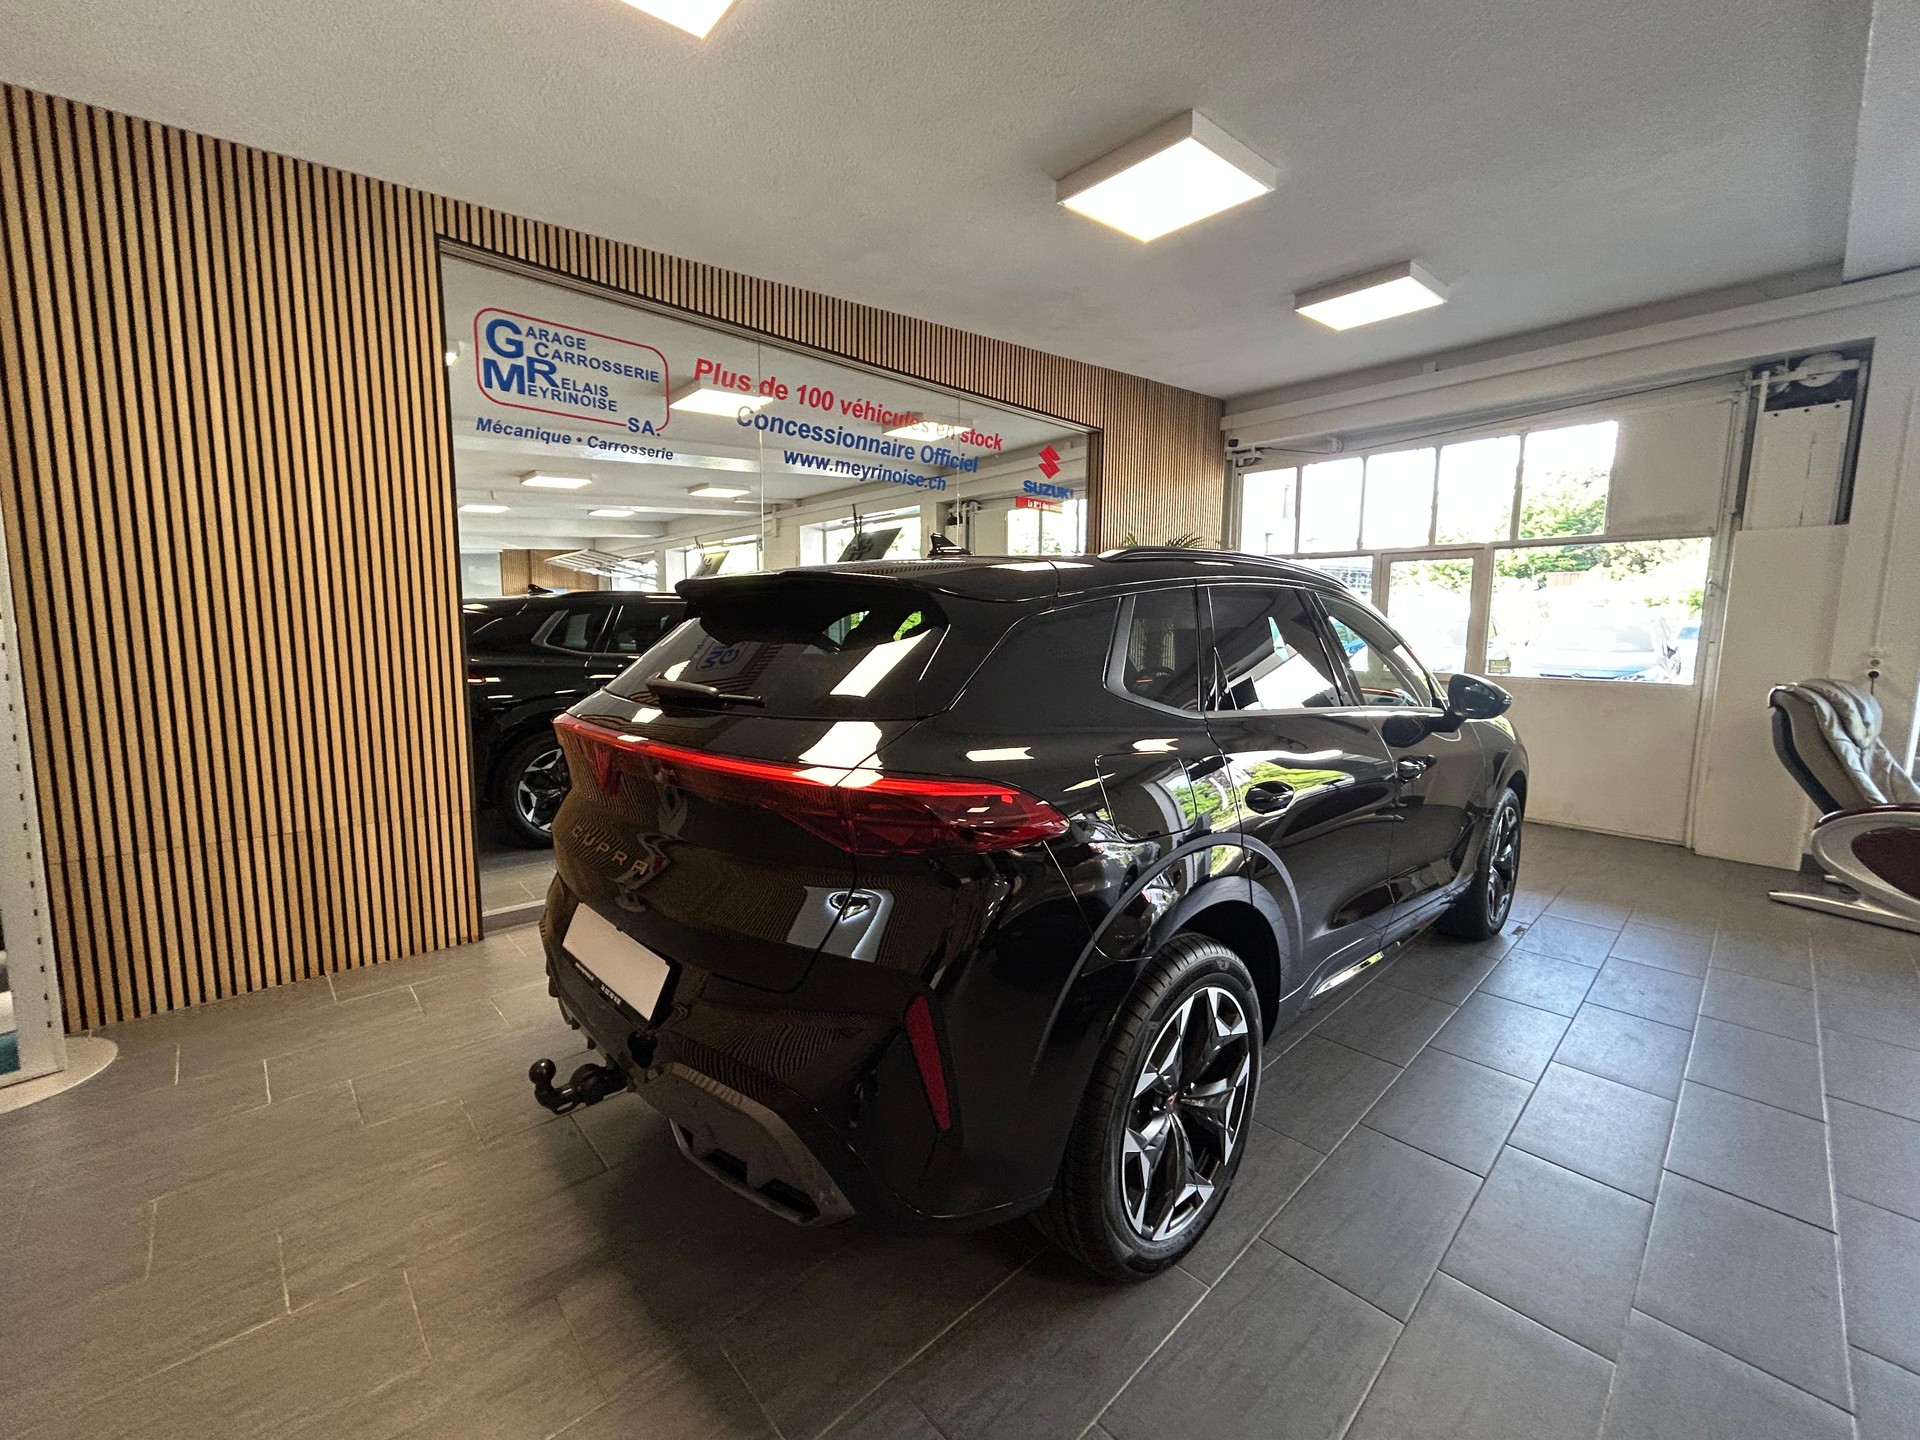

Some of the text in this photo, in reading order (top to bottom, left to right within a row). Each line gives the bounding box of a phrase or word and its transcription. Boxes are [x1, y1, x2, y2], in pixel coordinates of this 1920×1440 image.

[534, 341, 660, 383] CARROSSERIE
[694, 358, 751, 392] Plus
[759, 376, 788, 400] de
[797, 384, 834, 411] 100
[840, 398, 929, 433] véhicules
[960, 429, 1003, 450] stock
[476, 417, 674, 460] Mécanique Carrosserie
[737, 406, 979, 473] Concessionnaire Officiel
[783, 450, 947, 491] www.meyrinoise.ch
[1023, 480, 1074, 499] SUZUKI
